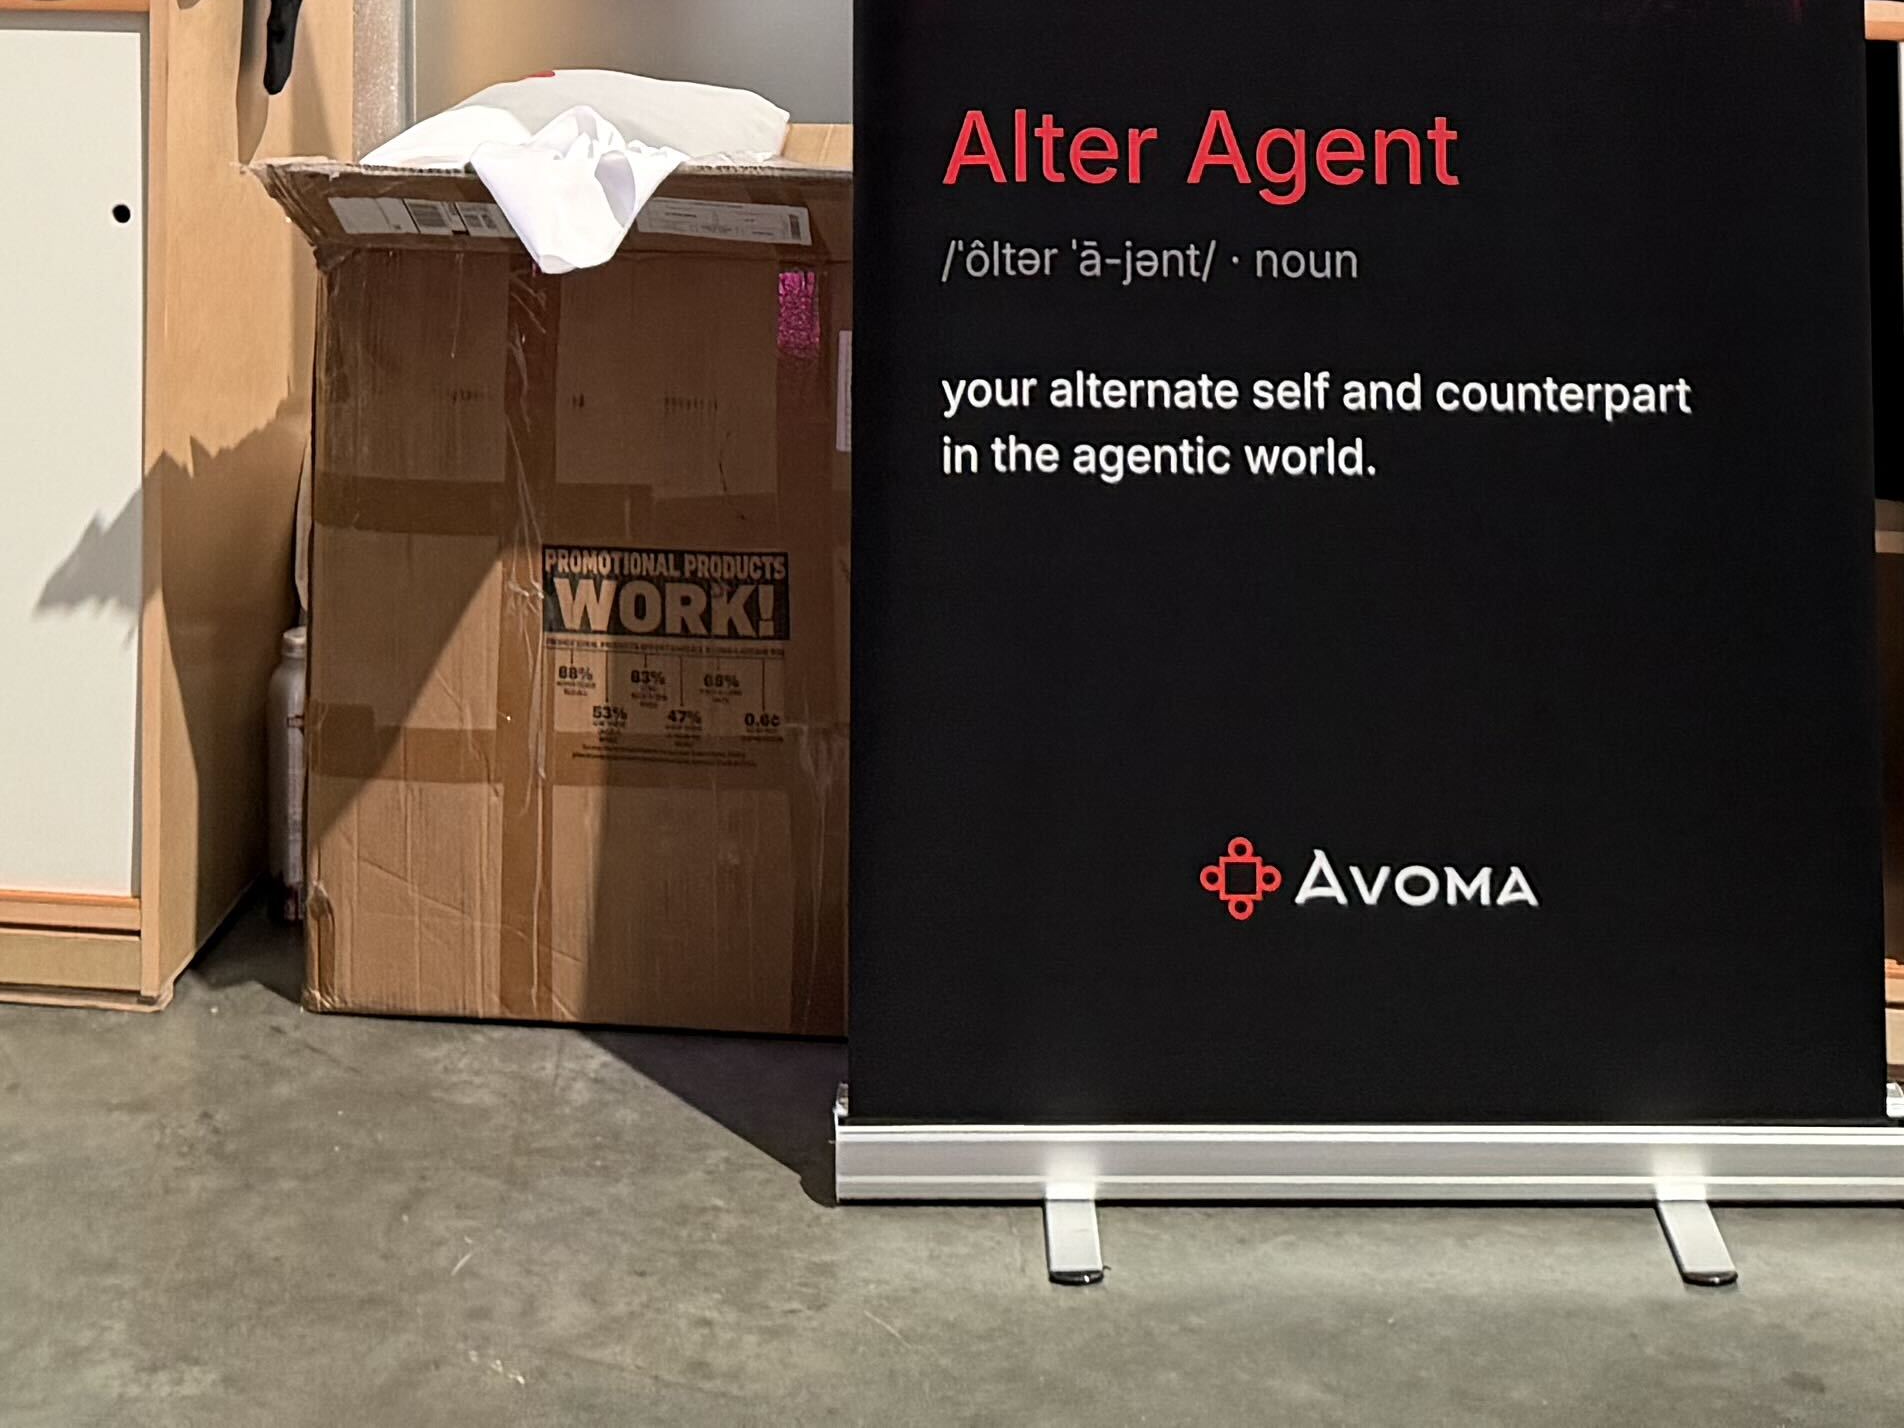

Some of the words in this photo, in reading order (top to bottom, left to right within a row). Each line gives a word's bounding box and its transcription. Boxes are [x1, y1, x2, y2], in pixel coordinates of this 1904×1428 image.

[943, 109, 1157, 184] Alter
[1187, 110, 1459, 205] Agent
[1257, 250, 1357, 278] noun
[942, 378, 1037, 418] your
[1050, 370, 1238, 409] alternate
[1253, 371, 1330, 409] self
[1343, 373, 1421, 410] and
[1436, 377, 1691, 421] counterpart
[944, 436, 977, 474] in
[991, 435, 1059, 472] the
[1073, 436, 1230, 483] agentic
[1245, 437, 1375, 475] world.
[544, 548, 681, 577] PROMOTIONAL
[684, 553, 786, 580] PRODUCTS
[553, 577, 775, 638] WORK!
[592, 705, 628, 721] 53%
